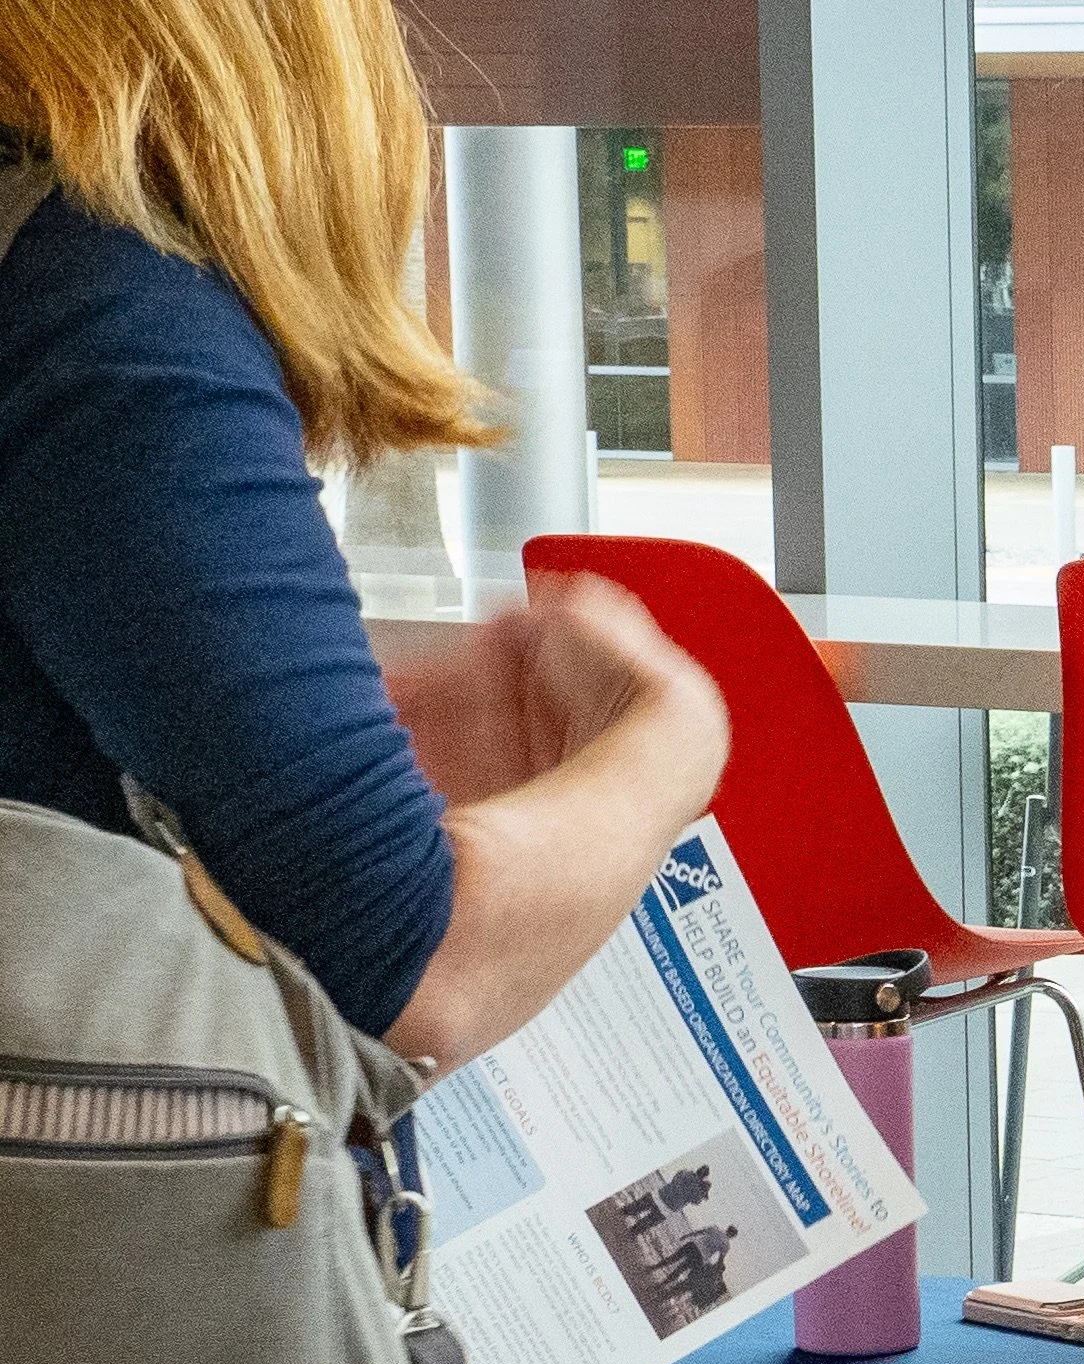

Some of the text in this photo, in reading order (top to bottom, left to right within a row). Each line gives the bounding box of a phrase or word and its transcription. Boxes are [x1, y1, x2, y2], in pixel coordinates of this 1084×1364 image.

[503, 1088, 536, 1136] GOALS
[628, 901, 675, 973] MMUNITY
[662, 967, 697, 1015] BASED
[685, 1010, 751, 1112] ORGANIZATION
[741, 1107, 794, 1183] DIRECTORY
[675, 909, 872, 1237] HELP BUILD an Equitable Shoreline!
[699, 897, 893, 1223] SHARE Your Community's Stories to
[565, 1232, 590, 1262] WHO
[583, 1262, 598, 1277] IS
